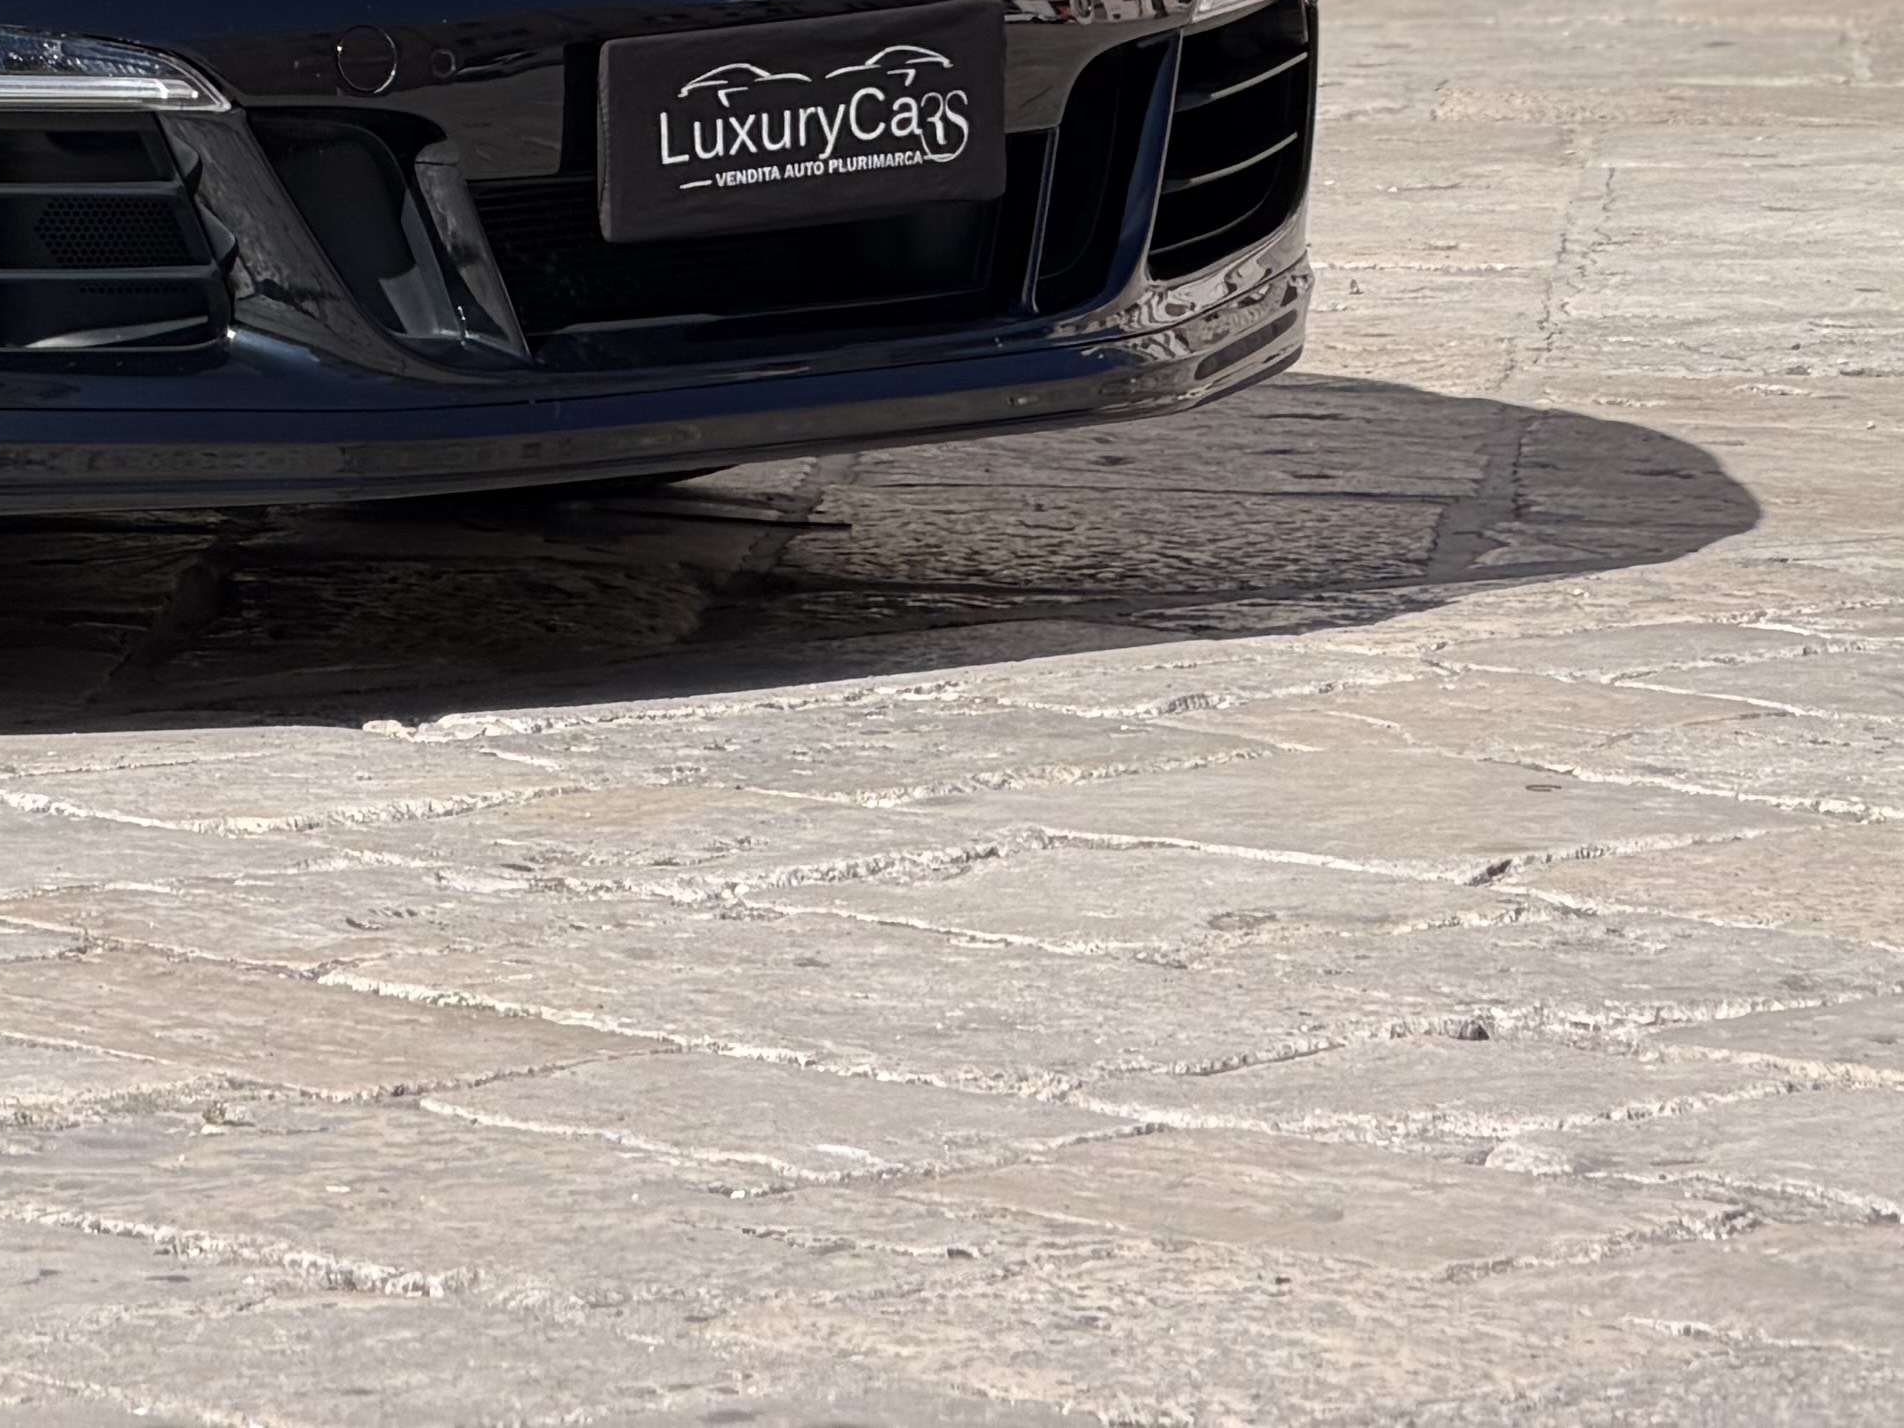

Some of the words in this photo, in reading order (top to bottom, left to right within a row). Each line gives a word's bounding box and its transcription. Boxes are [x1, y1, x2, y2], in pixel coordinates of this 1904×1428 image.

[715, 166, 782, 188] VENDITA
[784, 159, 826, 179] AUTO
[828, 149, 924, 174] PLURIMARCA
